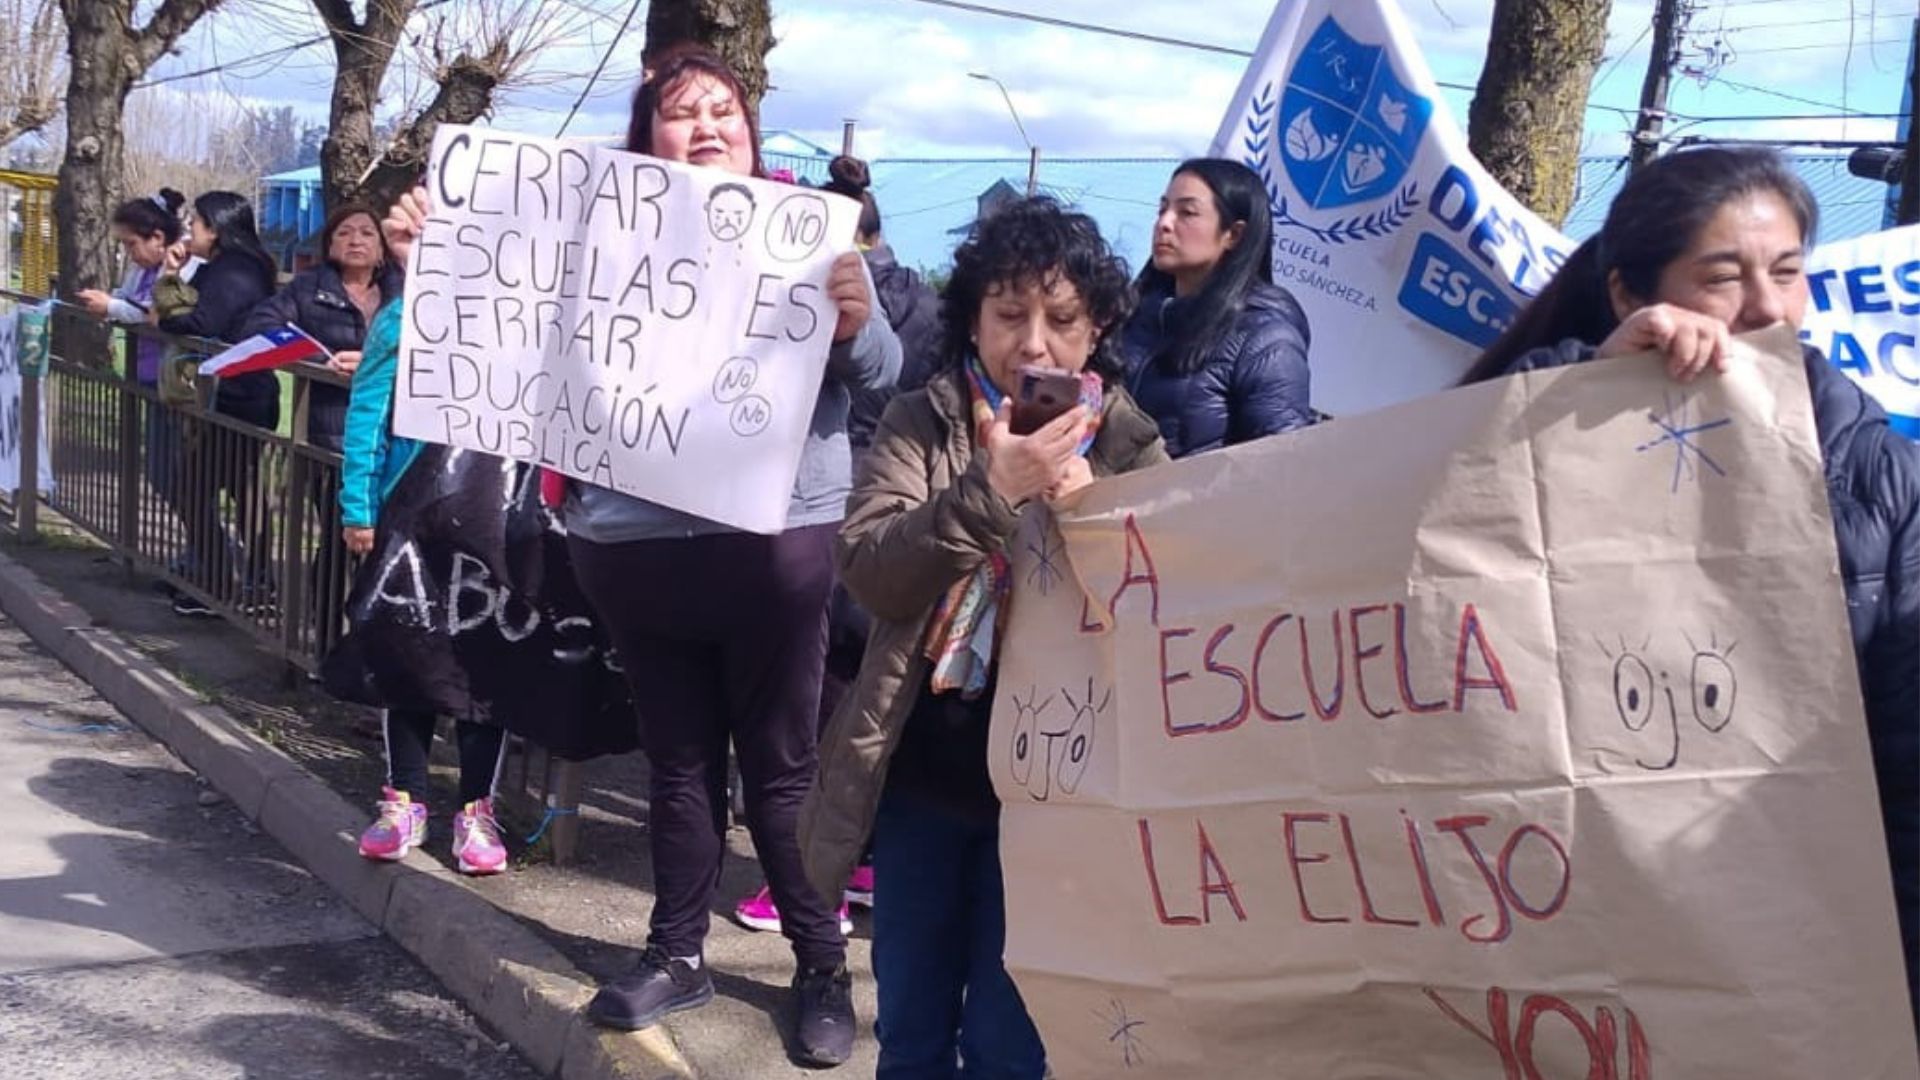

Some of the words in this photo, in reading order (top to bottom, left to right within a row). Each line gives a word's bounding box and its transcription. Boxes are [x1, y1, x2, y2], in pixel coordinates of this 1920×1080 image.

[438, 133, 672, 240] CERRAR
[781, 211, 821, 247] NO
[415, 219, 699, 321] ESCUELAS
[745, 273, 819, 343] ES
[411, 290, 642, 370] CERRAR
[1160, 602, 1518, 738] ESCUELA
[1139, 818, 1247, 926] LA
